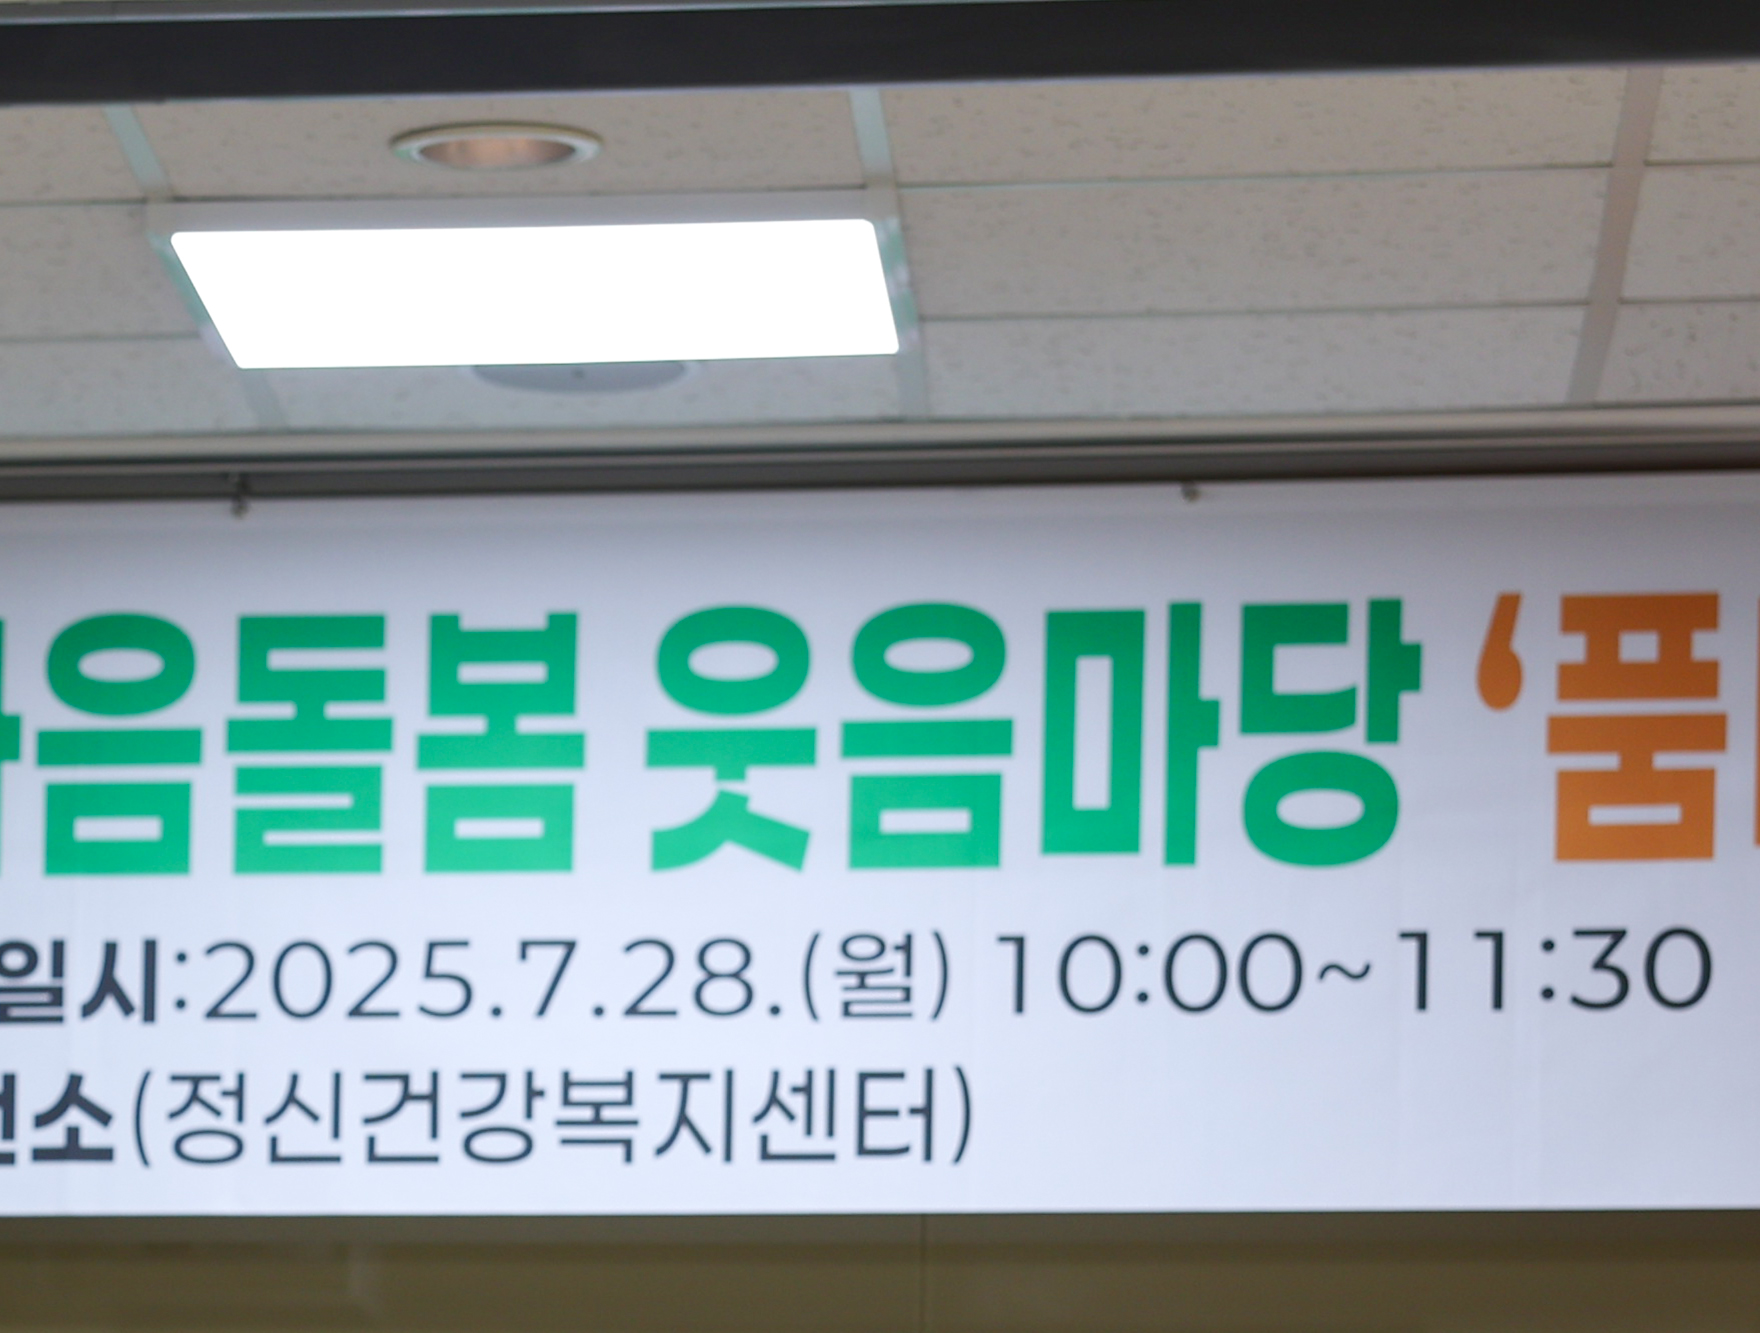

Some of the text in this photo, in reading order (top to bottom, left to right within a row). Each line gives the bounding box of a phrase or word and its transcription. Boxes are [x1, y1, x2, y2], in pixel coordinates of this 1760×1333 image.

[645, 596, 1425, 871] 웃음마당
[1476, 590, 1760, 861] ‘품
[996, 924, 1715, 1016] 10:00~11:30
